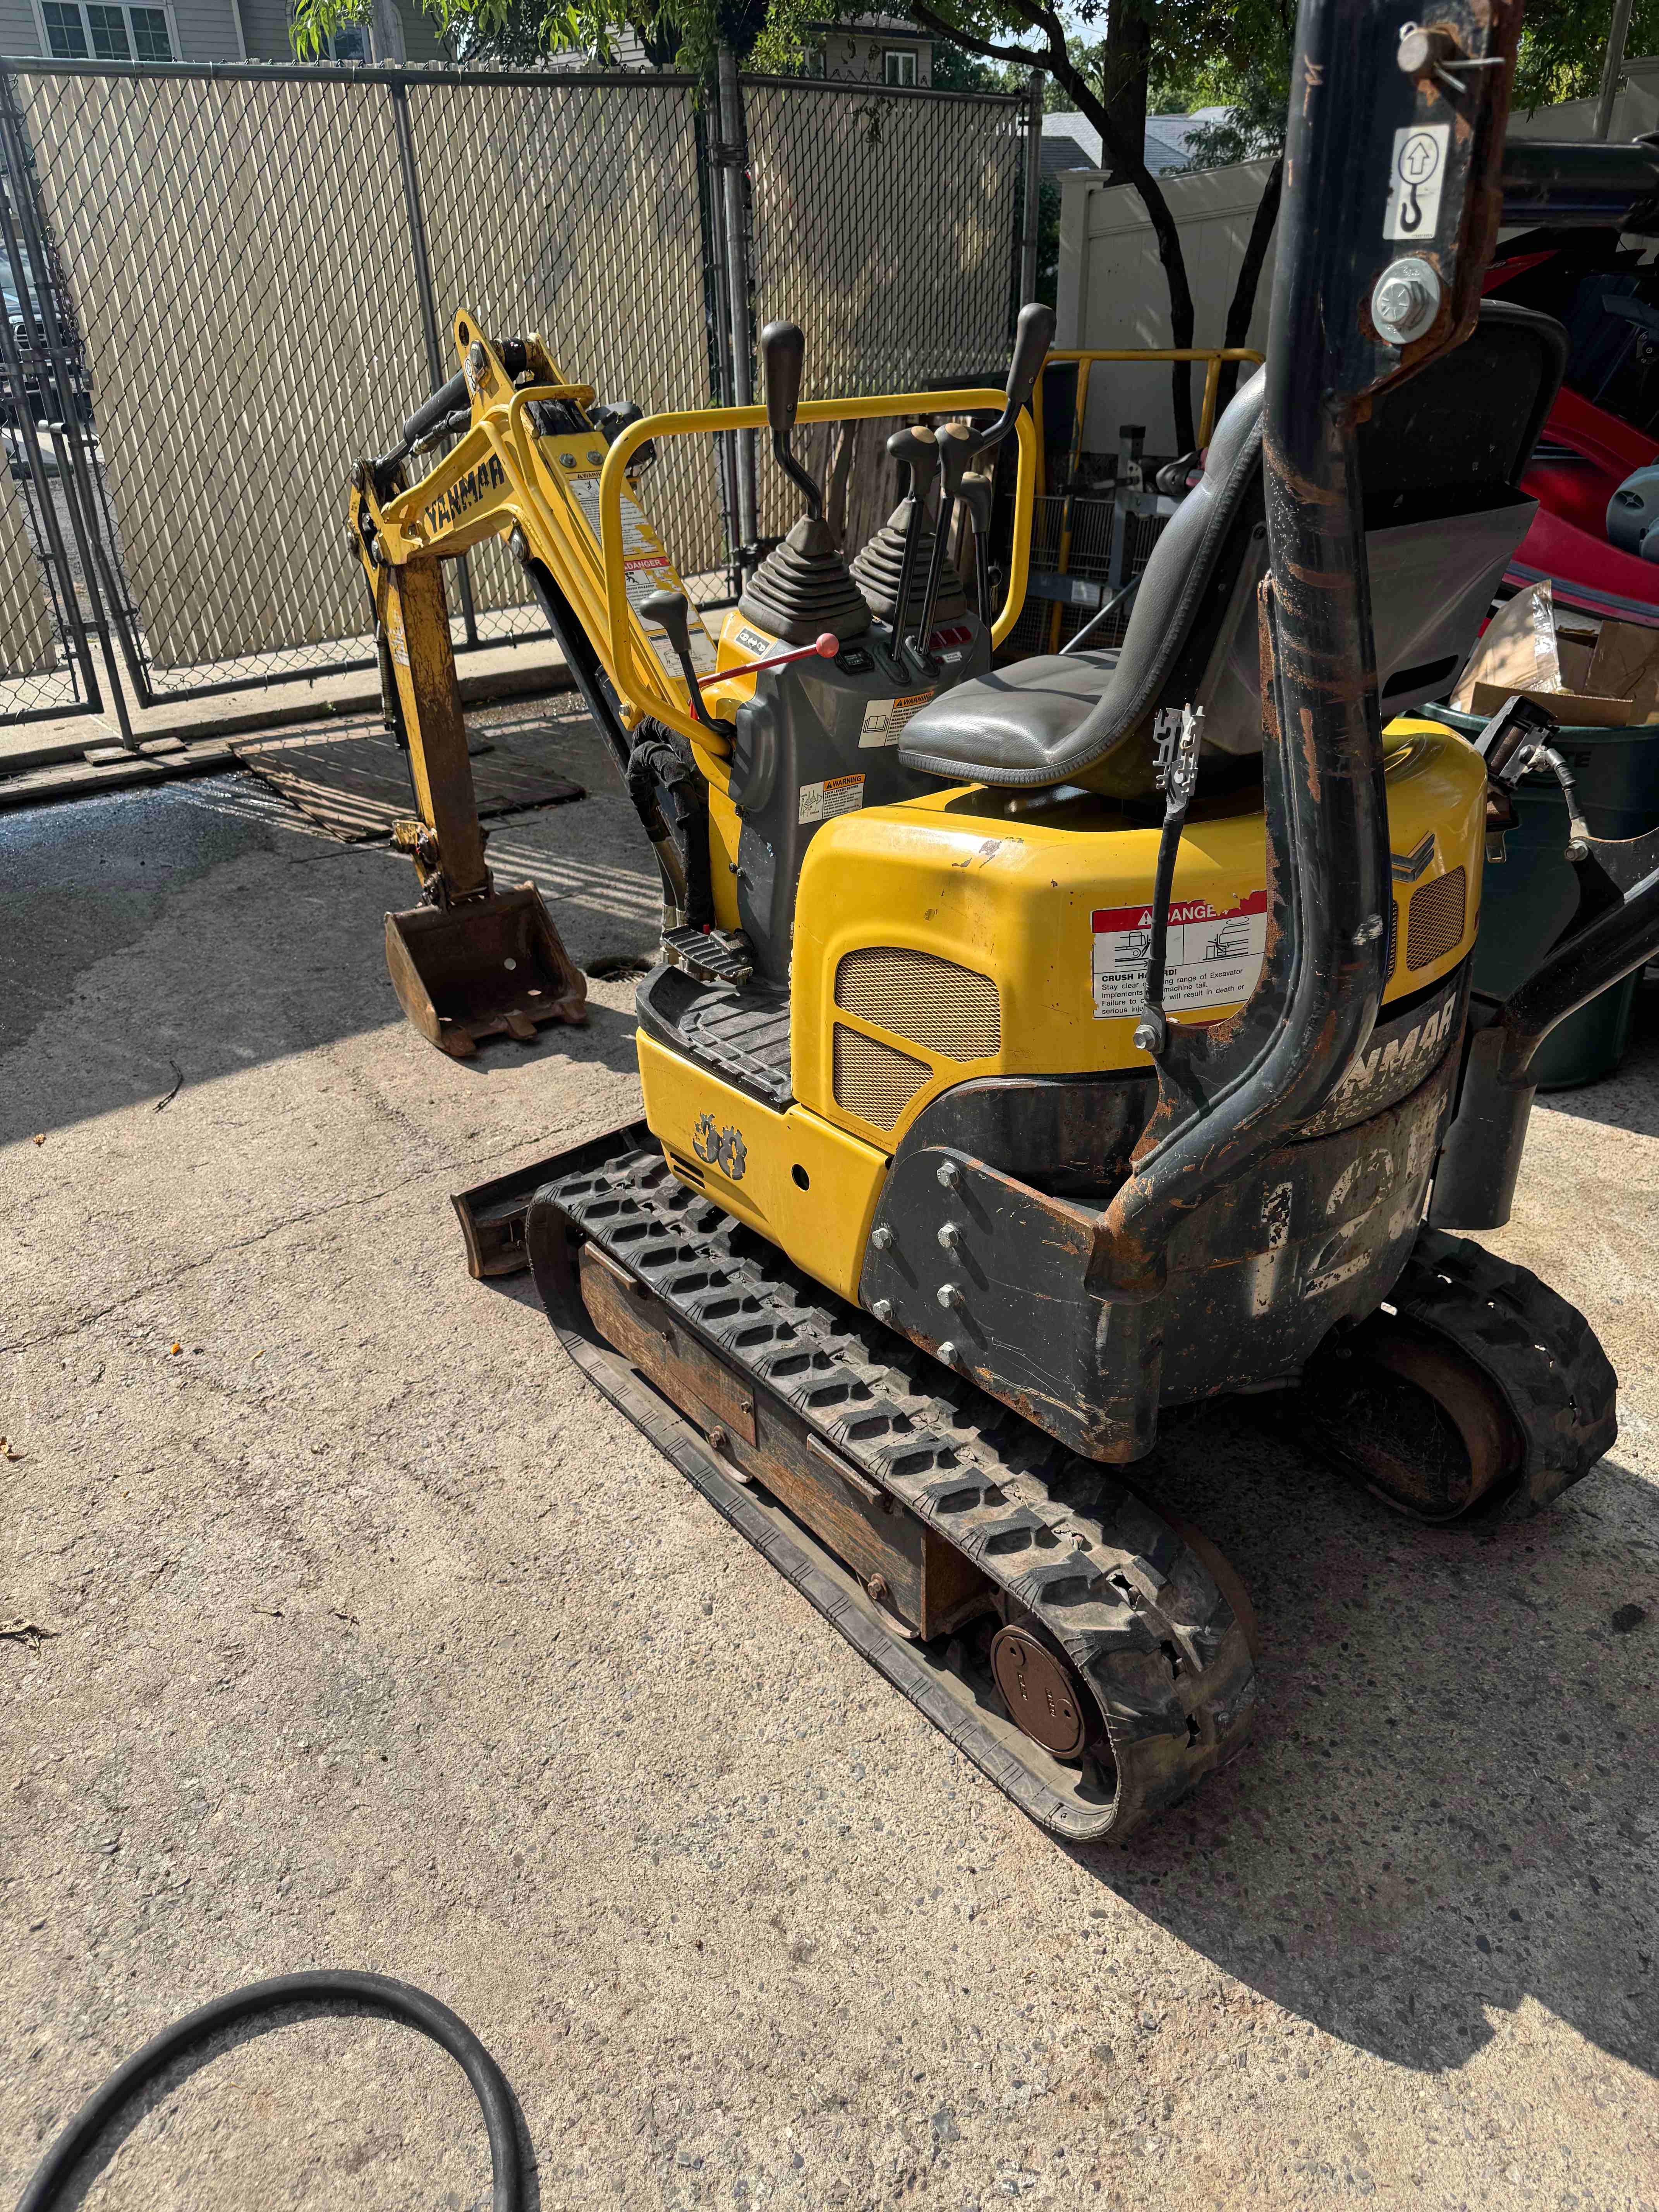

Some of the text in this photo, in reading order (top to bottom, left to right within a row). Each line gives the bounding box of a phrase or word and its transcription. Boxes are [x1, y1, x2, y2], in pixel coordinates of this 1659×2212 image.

[424, 452, 505, 534] YANMAR
[626, 559, 662, 570] DANGER
[833, 776, 862, 787] WARNING
[1102, 974, 1133, 982] CRUSH
[1210, 969, 1243, 979] Excavator
[1102, 990, 1143, 999] implements
[1163, 984, 1192, 993] machine
[1184, 990, 1203, 998] result
[1215, 985, 1234, 994] death
